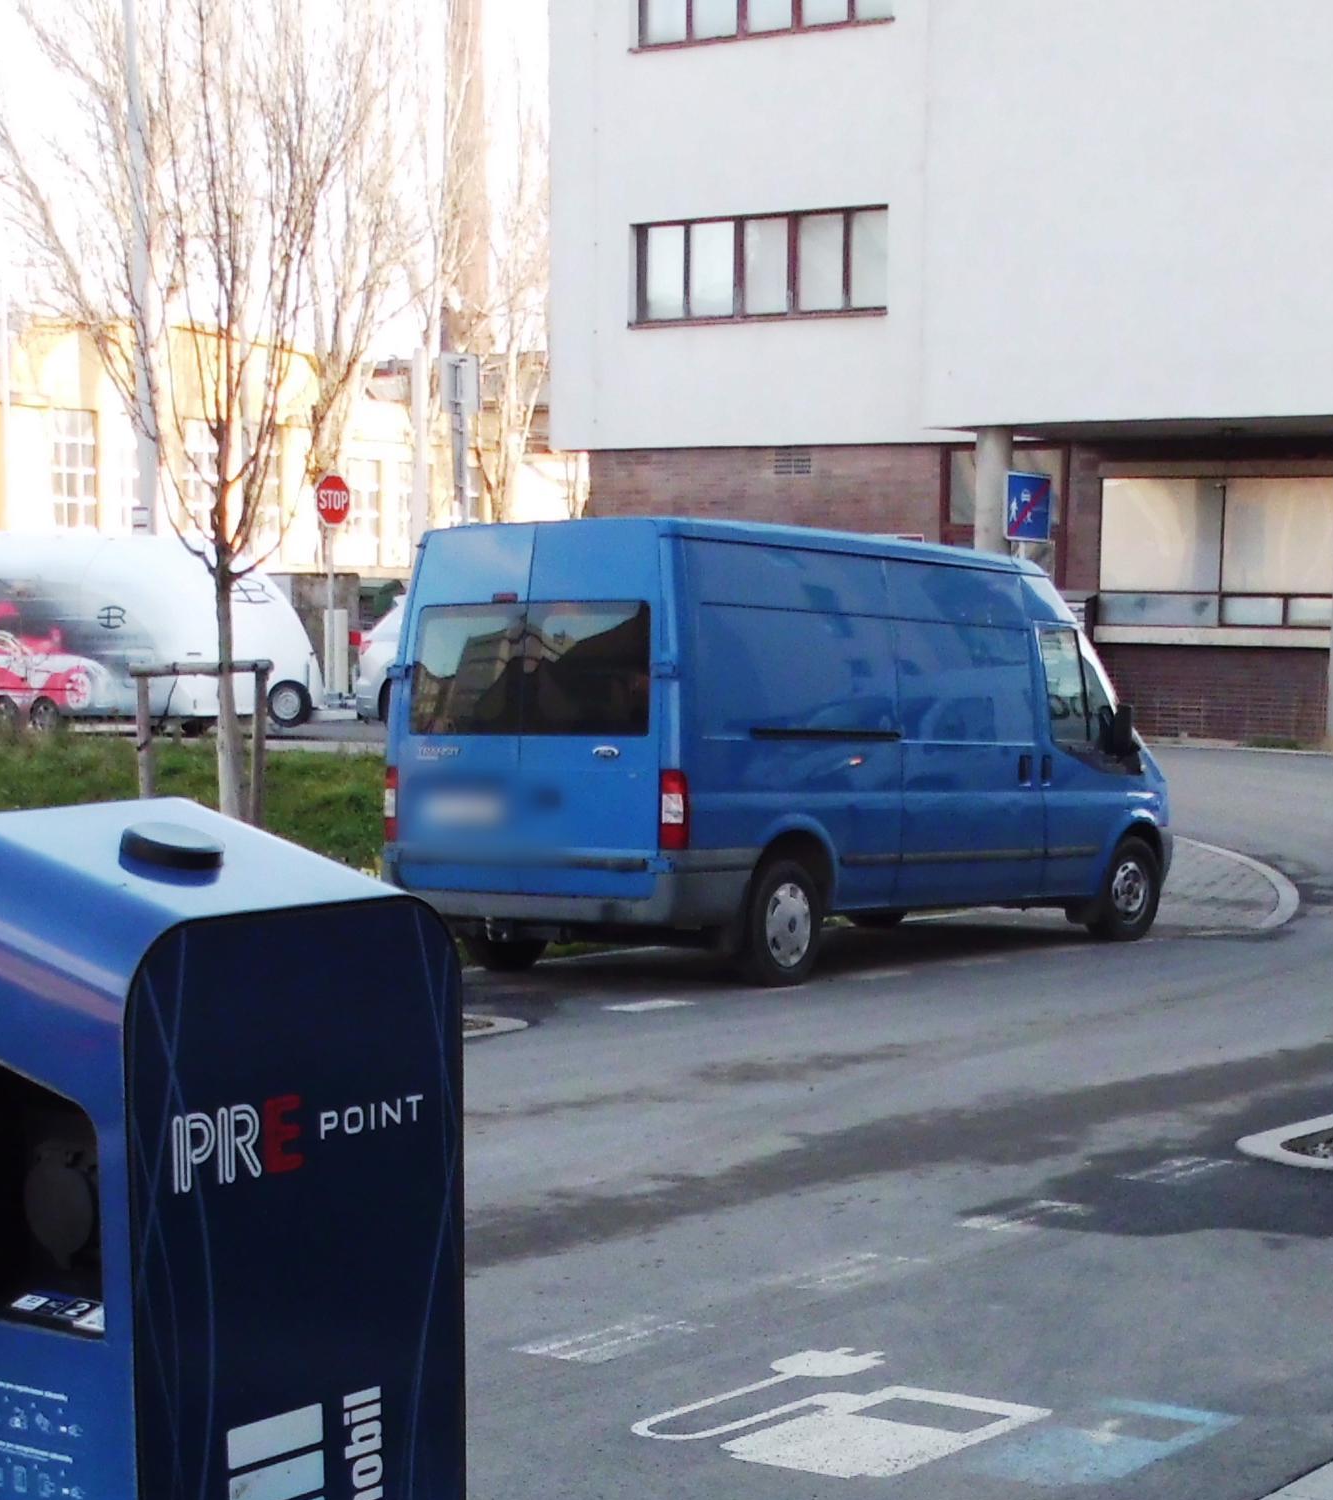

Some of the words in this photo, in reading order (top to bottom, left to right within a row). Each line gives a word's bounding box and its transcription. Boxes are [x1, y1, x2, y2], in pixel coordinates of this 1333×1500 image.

[319, 489, 348, 511] STOP
[172, 1094, 304, 1195] PRE
[320, 1095, 424, 1140] POINT
